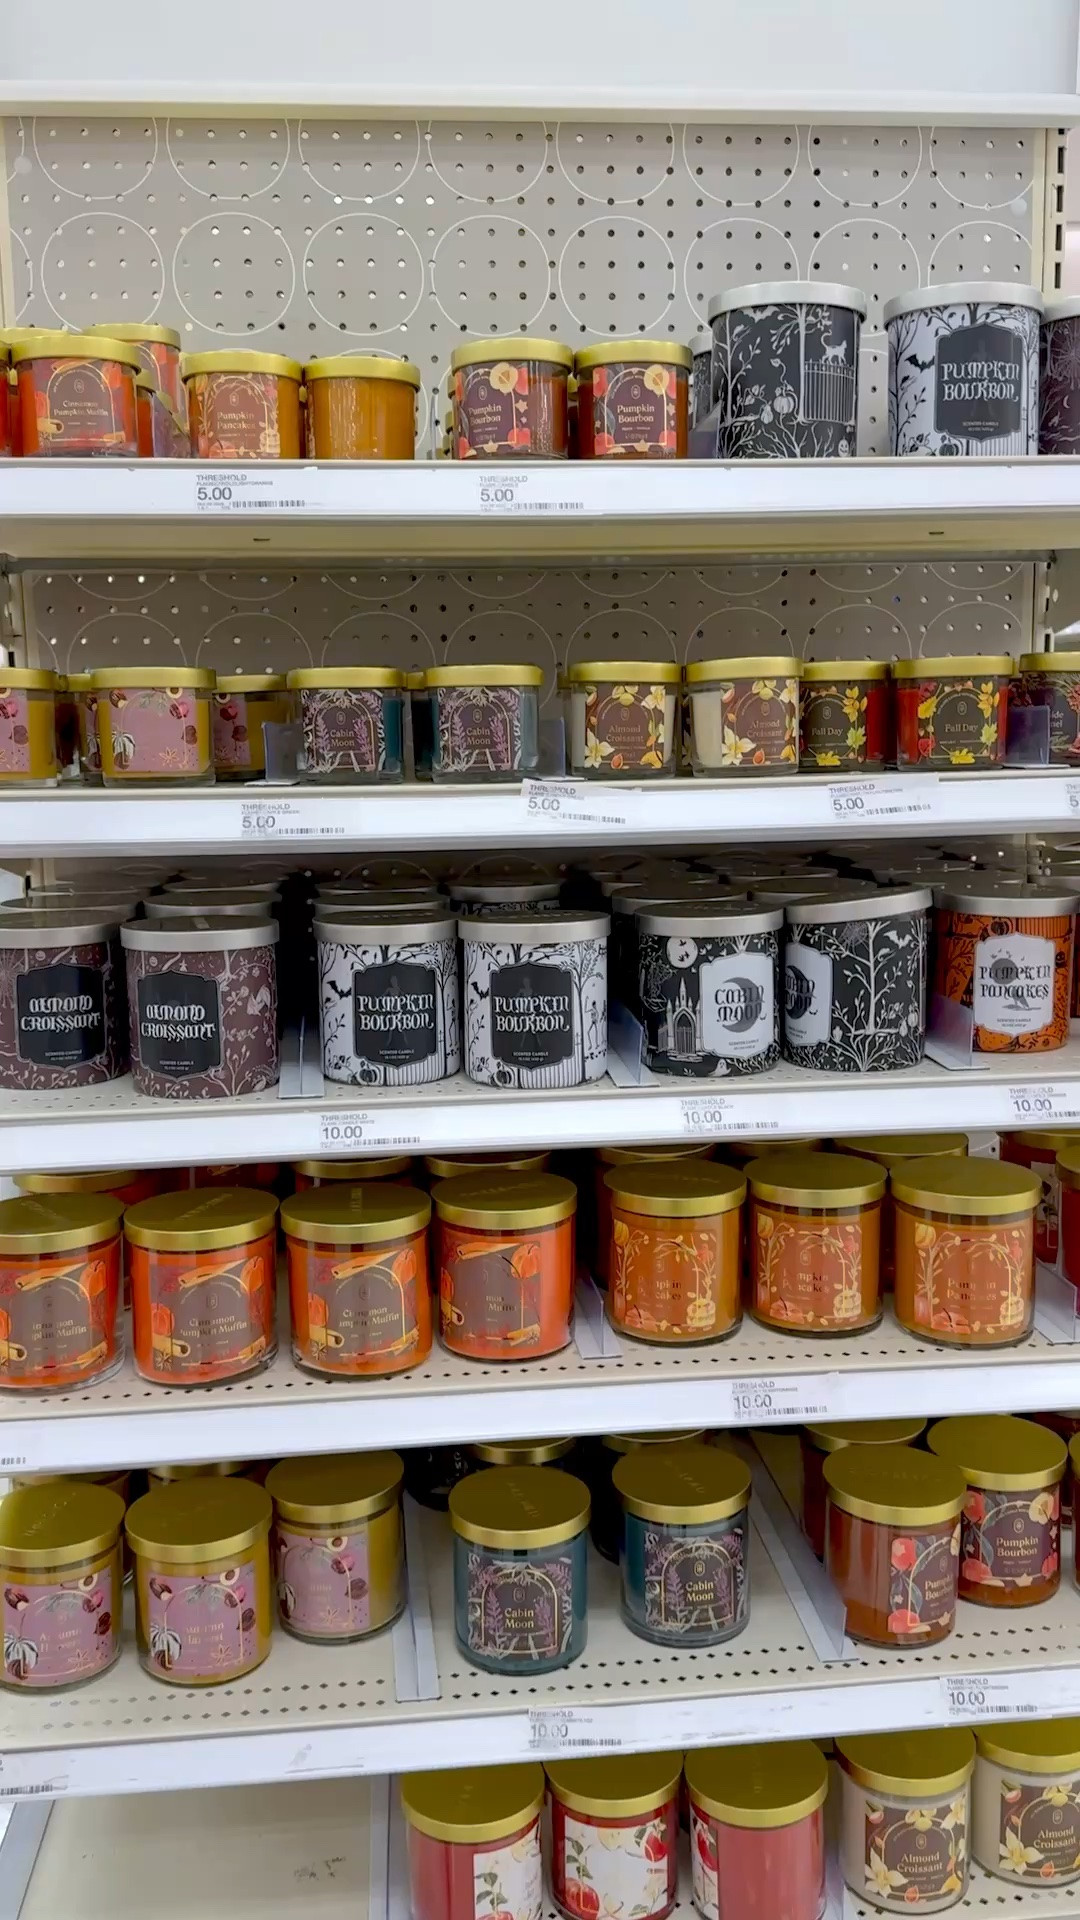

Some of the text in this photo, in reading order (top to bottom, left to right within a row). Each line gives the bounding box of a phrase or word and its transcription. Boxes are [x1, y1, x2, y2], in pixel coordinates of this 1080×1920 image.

[941, 360, 1020, 381] PUMPKIN
[942, 380, 1019, 402] BOURBON
[216, 411, 255, 423] Pumpkin
[468, 403, 502, 417] Pumpkin
[617, 404, 655, 416] Pumpkin
[470, 414, 502, 426] Bourbon
[617, 413, 654, 424] Bourbon
[216, 421, 257, 431] Pancakes
[196, 474, 248, 482] THRESHOLD
[197, 486, 232, 501] 5.00
[480, 488, 514, 502] 5.00
[608, 724, 642, 735] Almond
[751, 718, 781, 730] Almond
[944, 722, 979, 733] Fall Day
[329, 729, 355, 739] Cabin
[466, 727, 491, 738] Cabin
[810, 727, 844, 737] Fall Day
[330, 740, 355, 749] Moon
[467, 738, 491, 747] Moon
[527, 797, 561, 811] 5.00
[832, 797, 865, 811] 5.00
[242, 815, 276, 829] 5.00
[979, 965, 1051, 982] PUMPKIN
[714, 985, 765, 1006] CABIN
[979, 983, 1049, 1001] PANCAKES
[29, 995, 93, 1014] ALMOND
[356, 993, 435, 1013] PUMPKIN
[493, 995, 570, 1014] PUMPKIN
[145, 1003, 206, 1023] ALMOND
[716, 1004, 768, 1022] MOON
[20, 1011, 101, 1033] CROISSANT
[358, 1011, 435, 1032] BOURBON
[494, 1012, 570, 1034] BOURBON
[140, 1021, 217, 1042] CROISSANT
[1012, 1098, 1053, 1113] 10.00
[683, 1110, 723, 1125] 10.00
[322, 1125, 363, 1140] 10.00
[371, 1312, 400, 1325] Muffin
[56, 1325, 88, 1338] Muffin
[218, 1320, 248, 1334] Muffin
[733, 1394, 773, 1410] 10.00
[996, 1535, 1040, 1549] Pumpkin
[996, 1546, 1038, 1559] Bourbon
[685, 1579, 714, 1592] Cabin
[685, 1591, 715, 1602] Moon
[503, 1607, 535, 1619] Cabin
[504, 1618, 535, 1630] Moon
[949, 1690, 985, 1706] 10.00
[530, 1723, 569, 1739] 10.00
[1038, 1825, 1075, 1839] Almond
[1032, 1835, 1077, 1850] Croissant
[900, 1850, 940, 1864] Almond
[896, 1861, 943, 1874] Croissant
